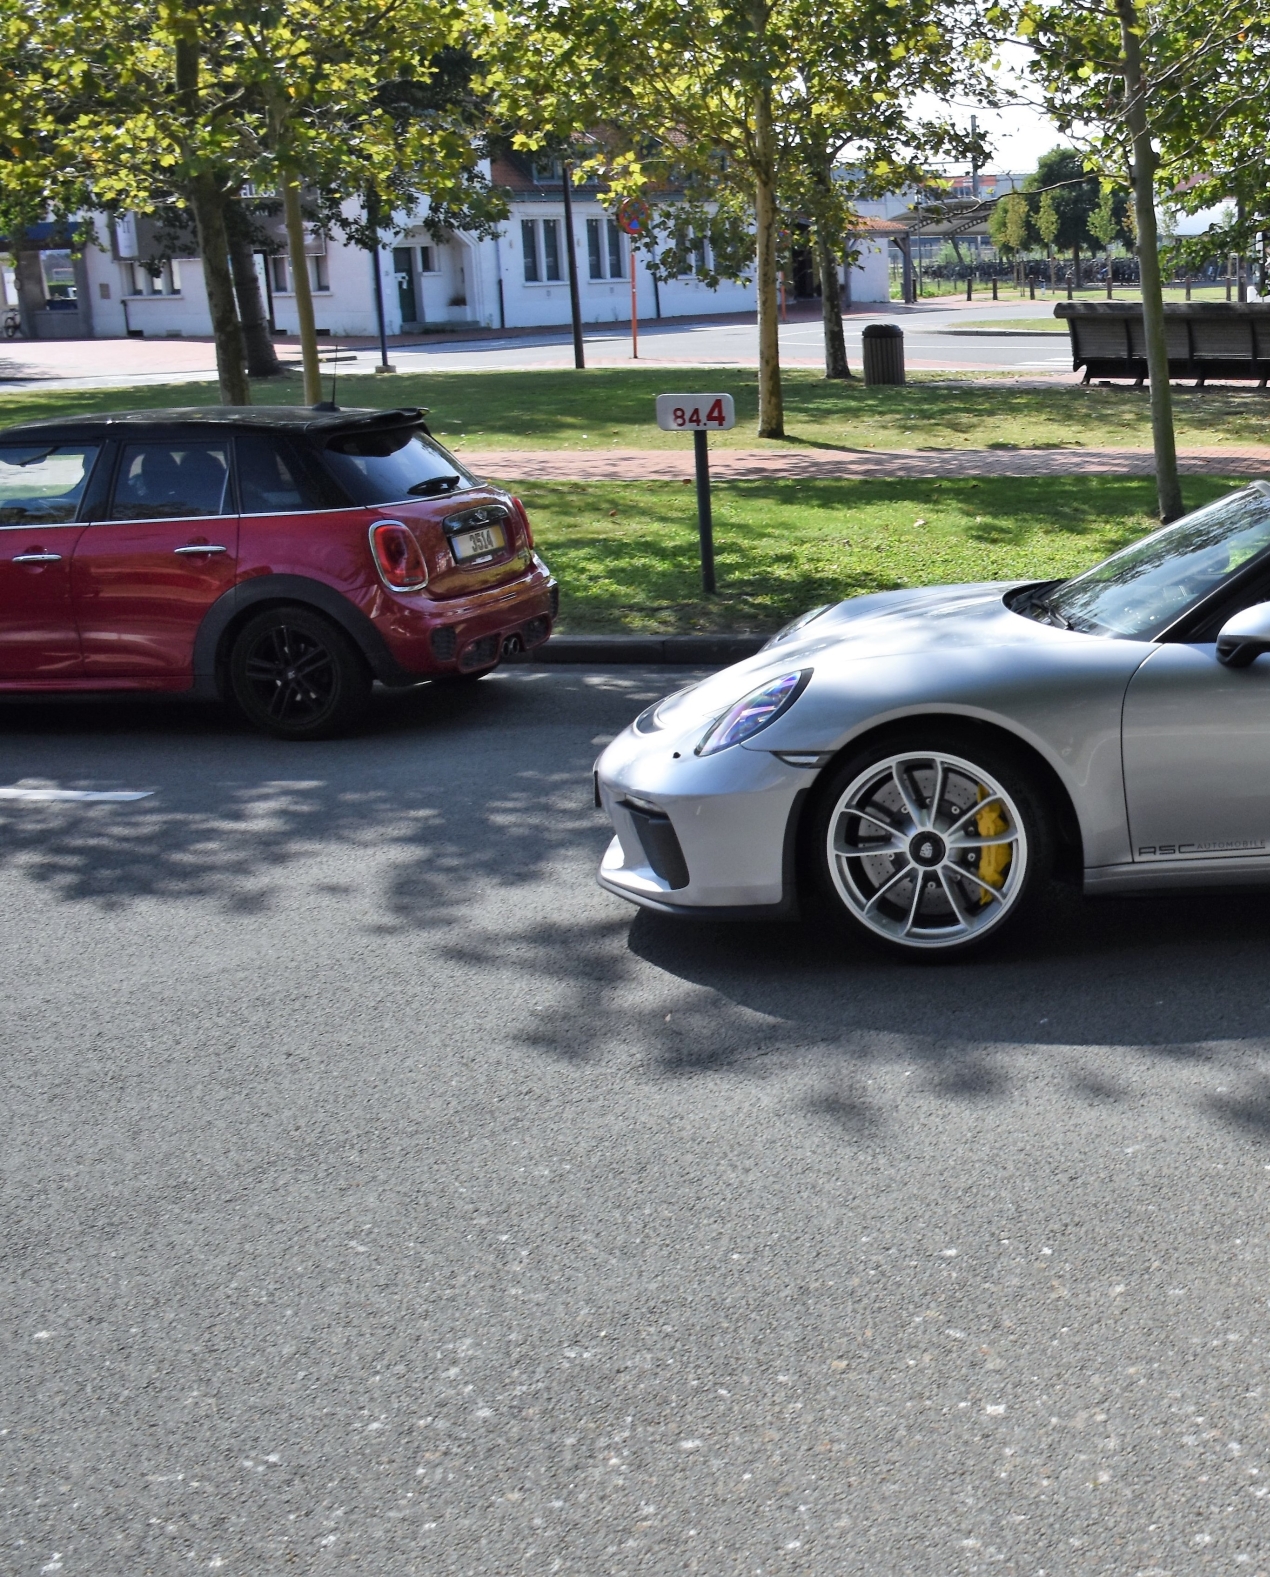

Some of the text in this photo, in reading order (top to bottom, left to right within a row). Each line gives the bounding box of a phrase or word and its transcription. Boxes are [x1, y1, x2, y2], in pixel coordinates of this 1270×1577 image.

[672, 398, 726, 427] 84.4
[469, 530, 494, 552] 3514
[1138, 839, 1266, 856] ASC AUTOMOBILE
